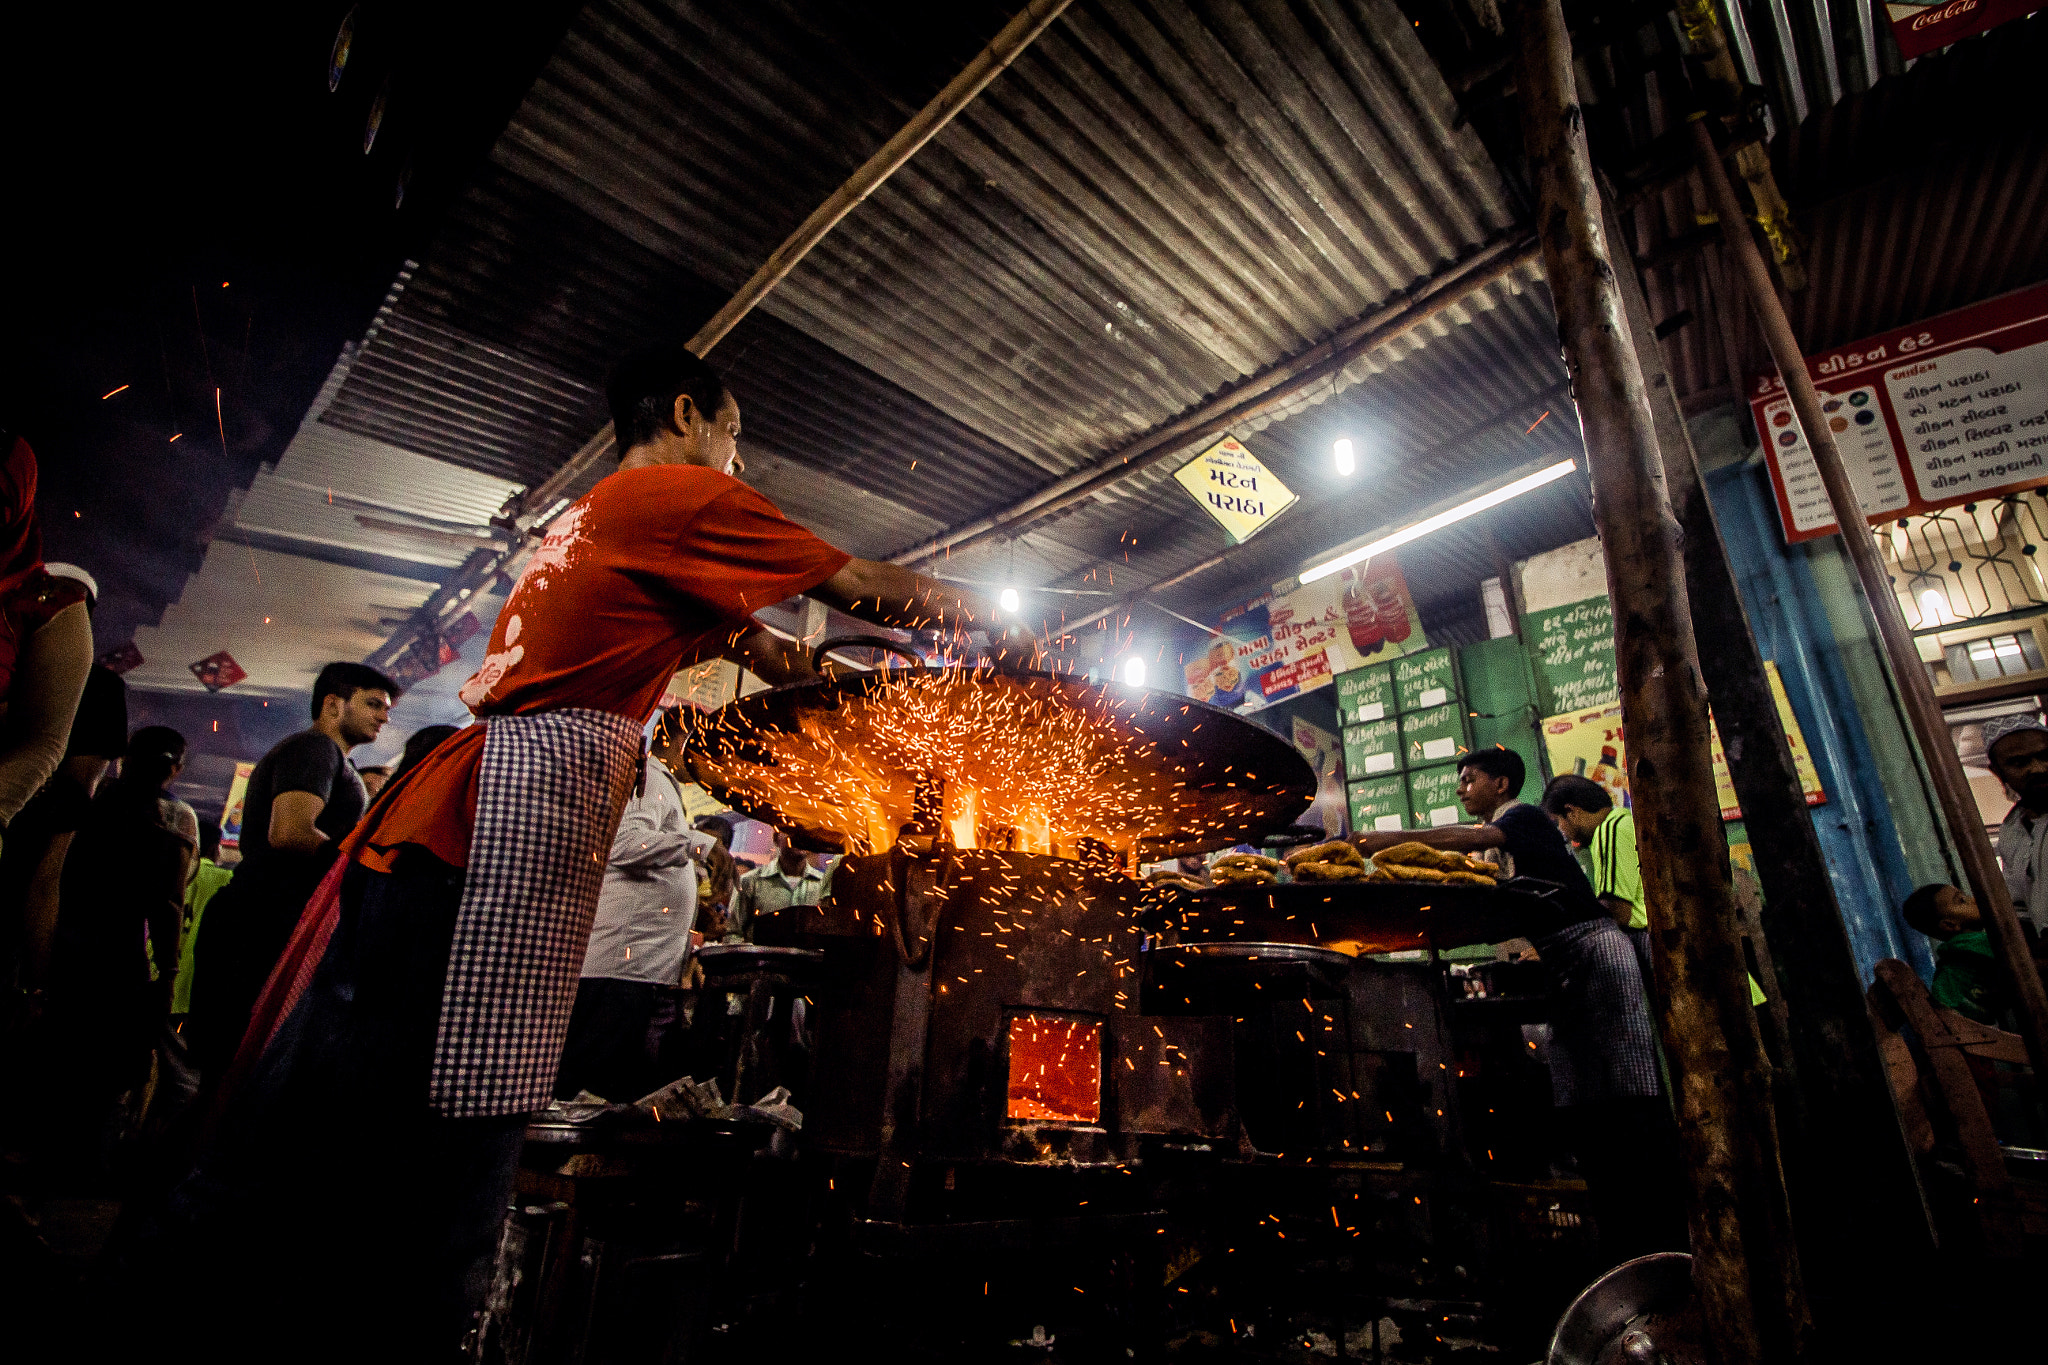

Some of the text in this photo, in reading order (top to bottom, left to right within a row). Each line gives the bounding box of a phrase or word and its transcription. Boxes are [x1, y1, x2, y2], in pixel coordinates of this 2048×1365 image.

[1818, 346, 1887, 374] ચીકન
[1903, 369, 1990, 400] ચીકન પરાઠા
[1938, 394, 1972, 409] મટન
[1977, 381, 2021, 399] પરાઠા
[1914, 420, 1954, 435] ચીકન
[1920, 438, 1960, 453] ચીકન
[1926, 455, 1965, 471] ચીકન
[1210, 468, 1258, 492] મટન
[1931, 473, 1971, 489] ચીકન
[1207, 491, 1265, 517] પરાઠા
[1274, 616, 1317, 641] ચીકન
[1324, 605, 1339, 621] &
[1249, 627, 1336, 669] પરાઠા સેન્ટર
